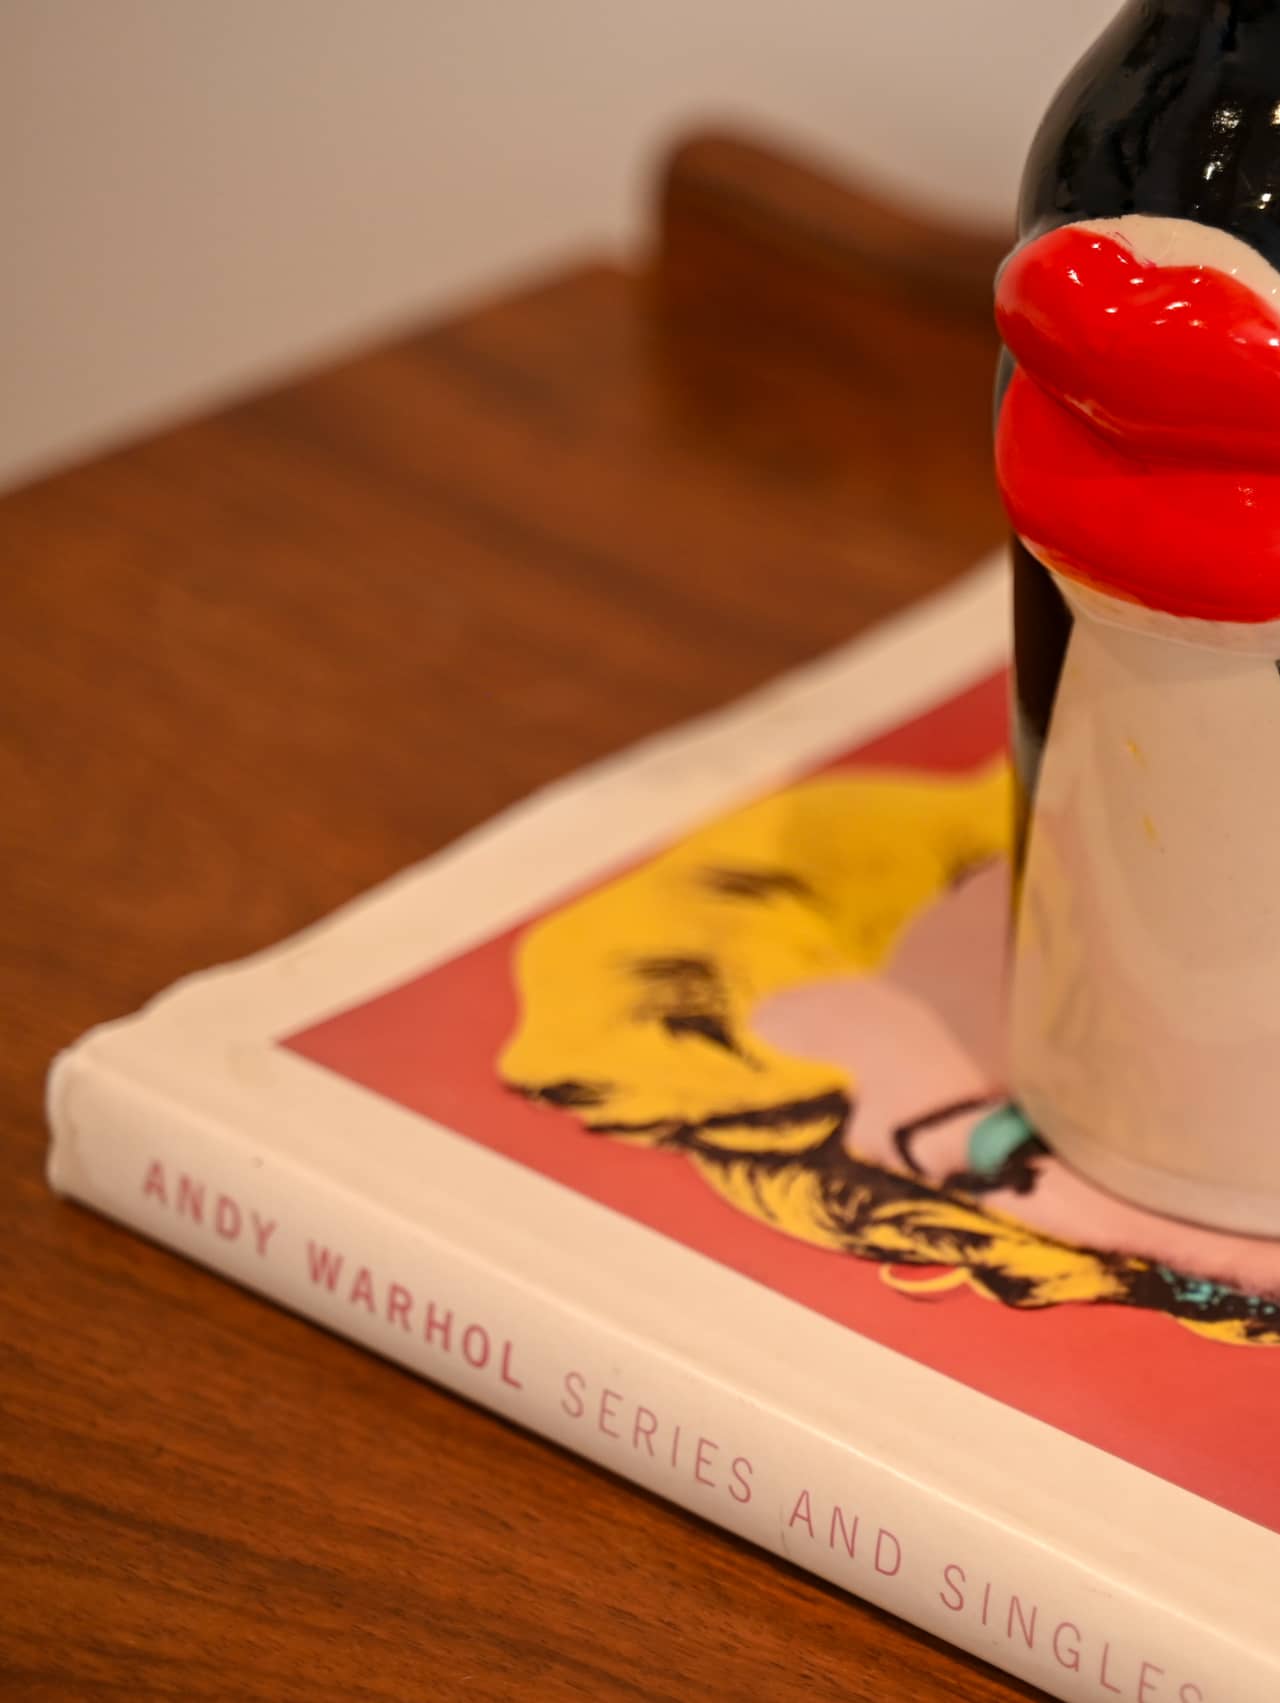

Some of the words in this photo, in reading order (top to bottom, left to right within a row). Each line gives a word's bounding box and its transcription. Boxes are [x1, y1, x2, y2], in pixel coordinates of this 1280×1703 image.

[143, 1159, 278, 1258] ANDY
[306, 1239, 524, 1391] WARHOL
[559, 1370, 754, 1504] SERIES
[787, 1489, 902, 1577] AND
